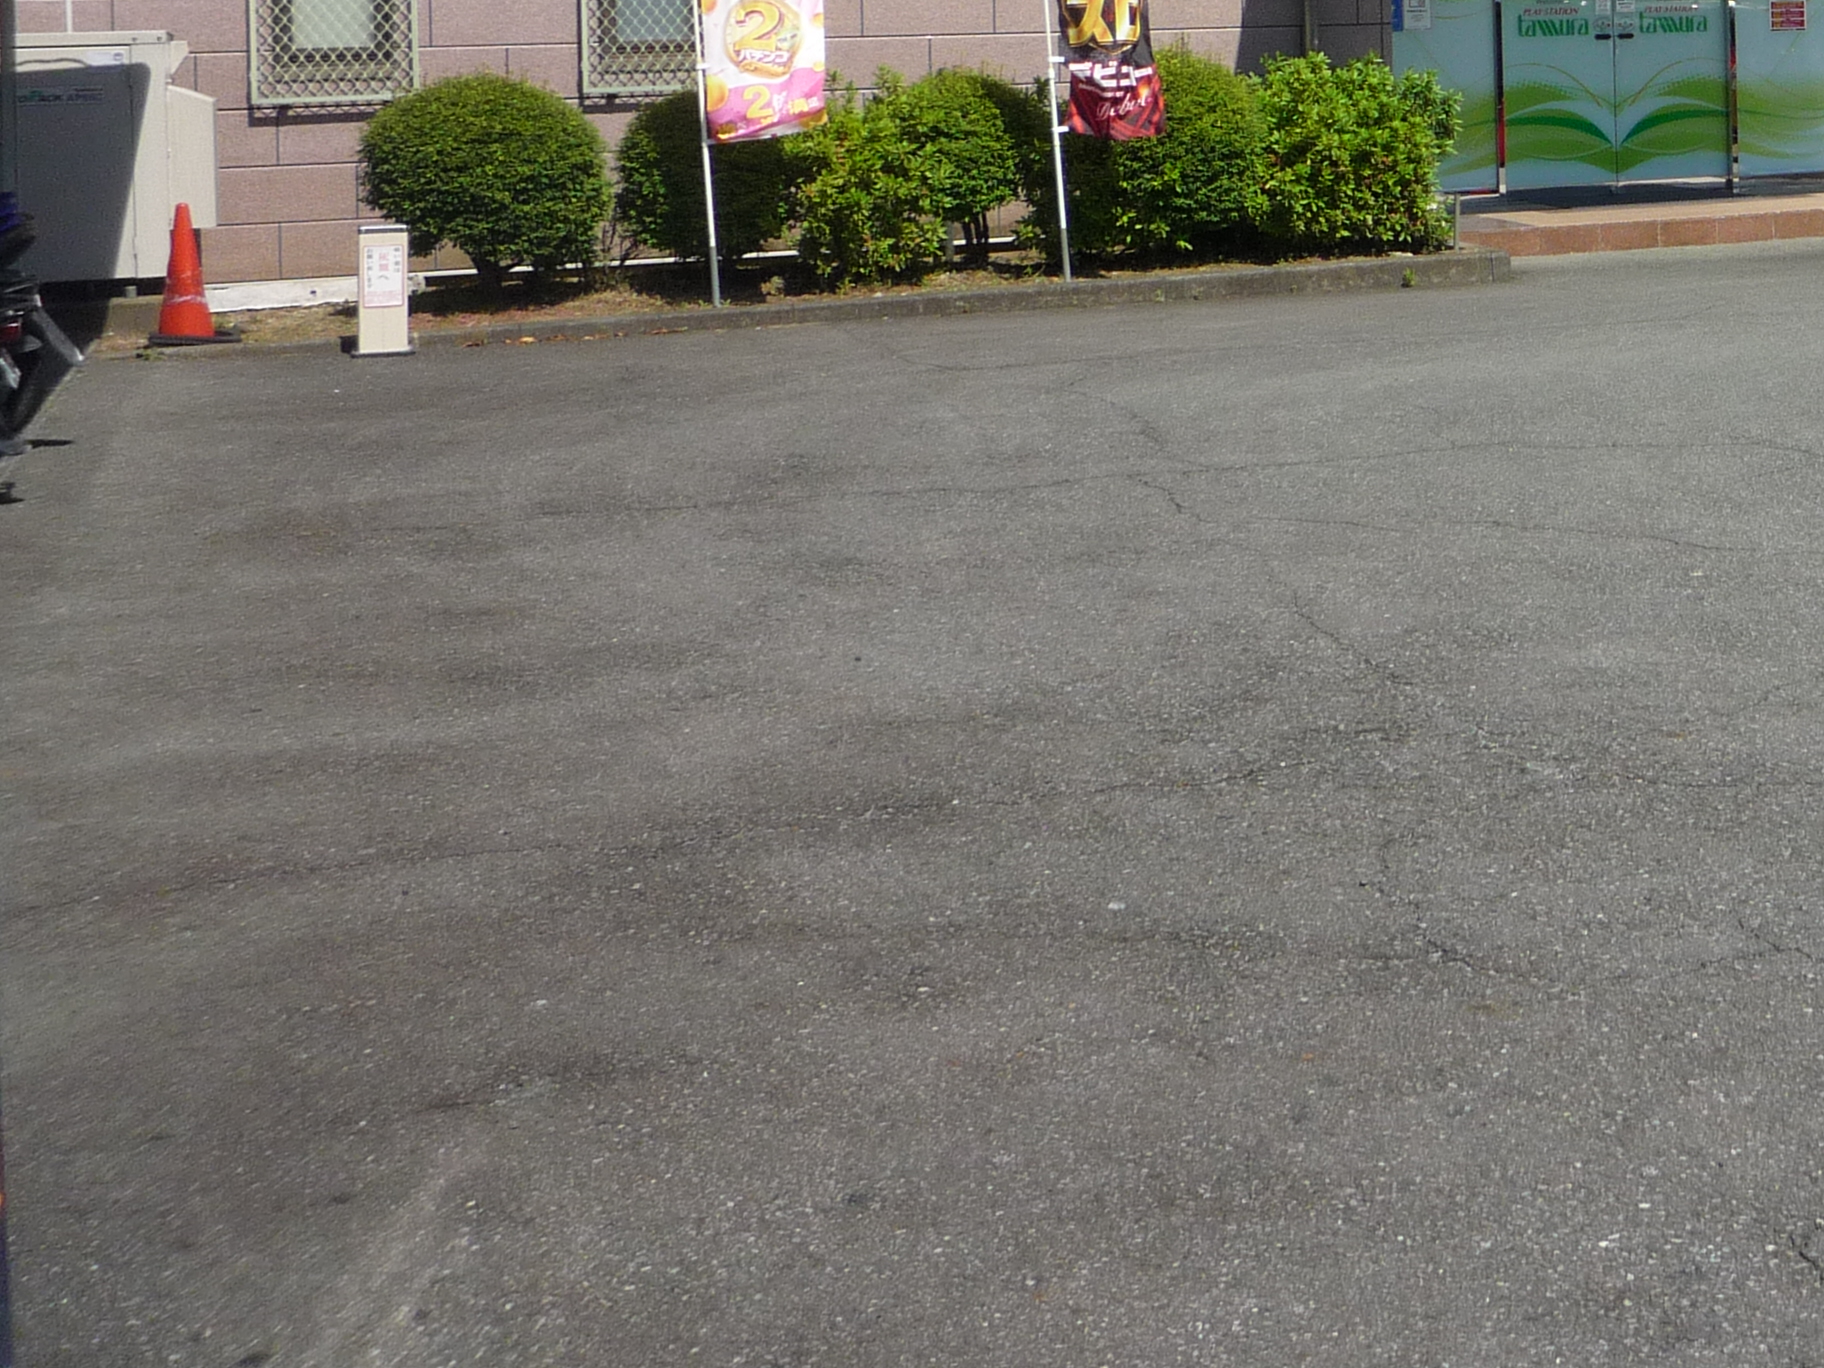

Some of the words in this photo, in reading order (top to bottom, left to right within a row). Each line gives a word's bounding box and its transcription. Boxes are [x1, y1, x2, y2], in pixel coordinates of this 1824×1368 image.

[734, 1, 784, 51] 2
[738, 48, 791, 64] パチンコ
